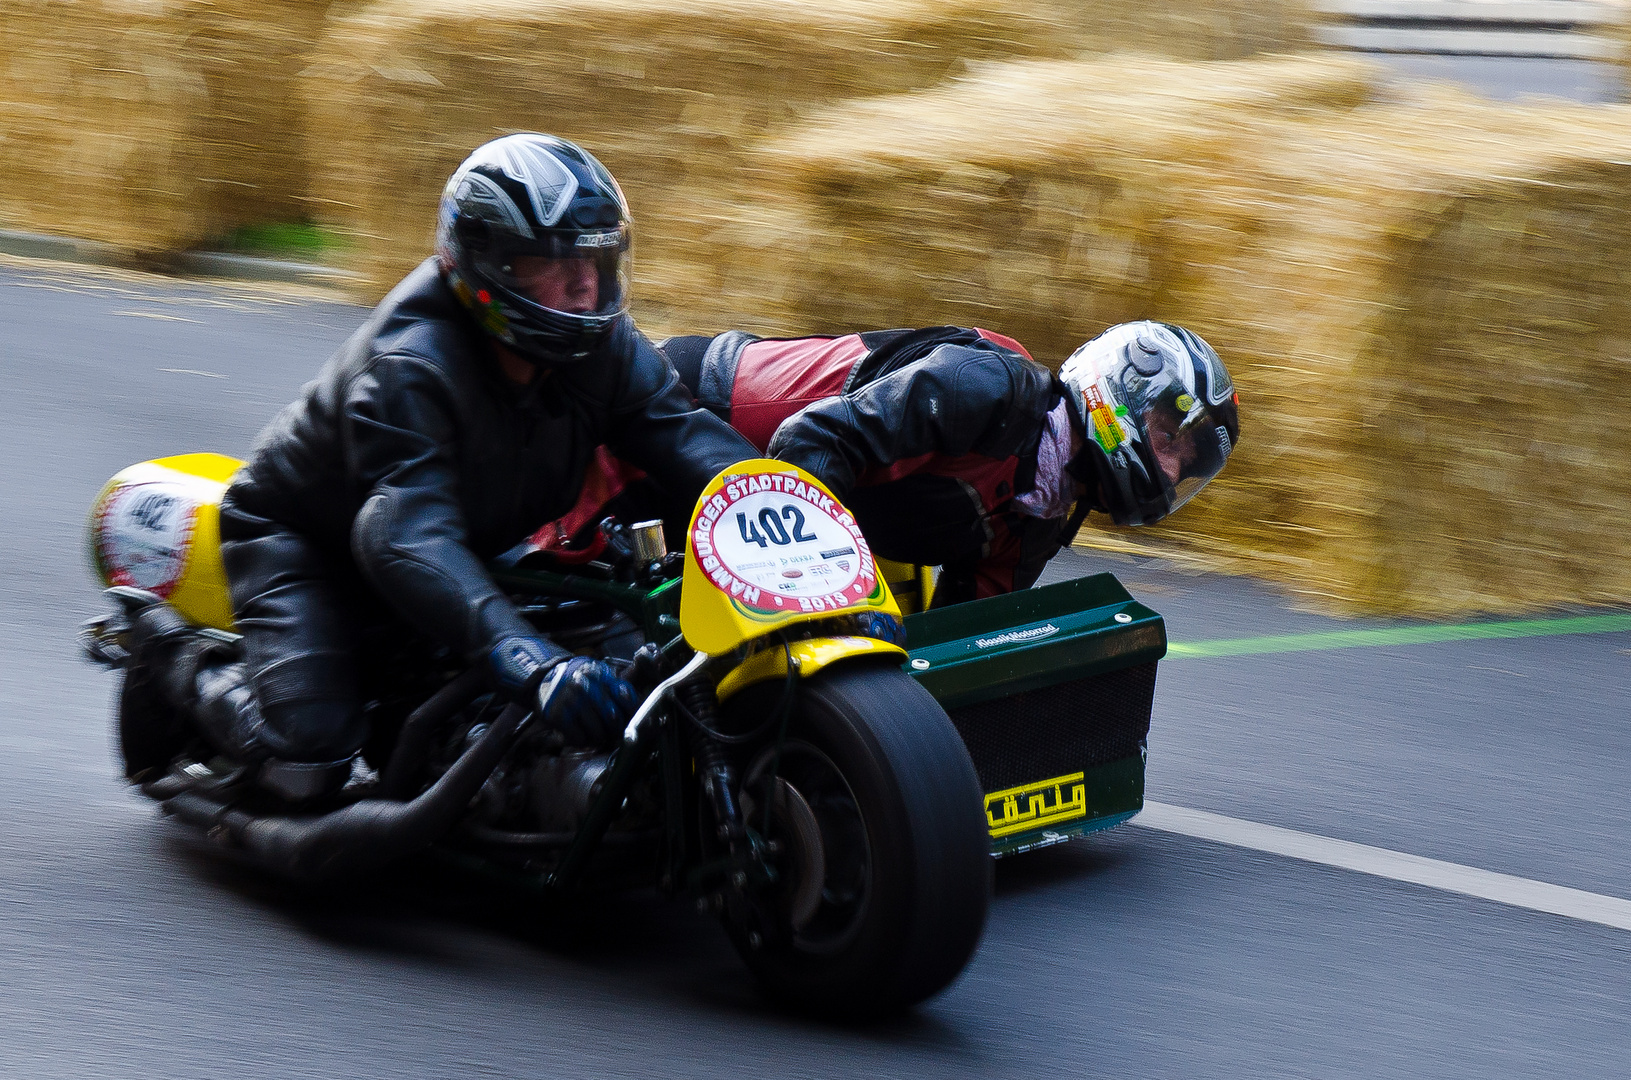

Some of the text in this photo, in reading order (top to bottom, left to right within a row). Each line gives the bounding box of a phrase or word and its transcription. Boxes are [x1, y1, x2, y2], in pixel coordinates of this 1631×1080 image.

[694, 493, 761, 605] HAMBURGER
[736, 503, 818, 549] 402
[798, 592, 849, 612] 2013
